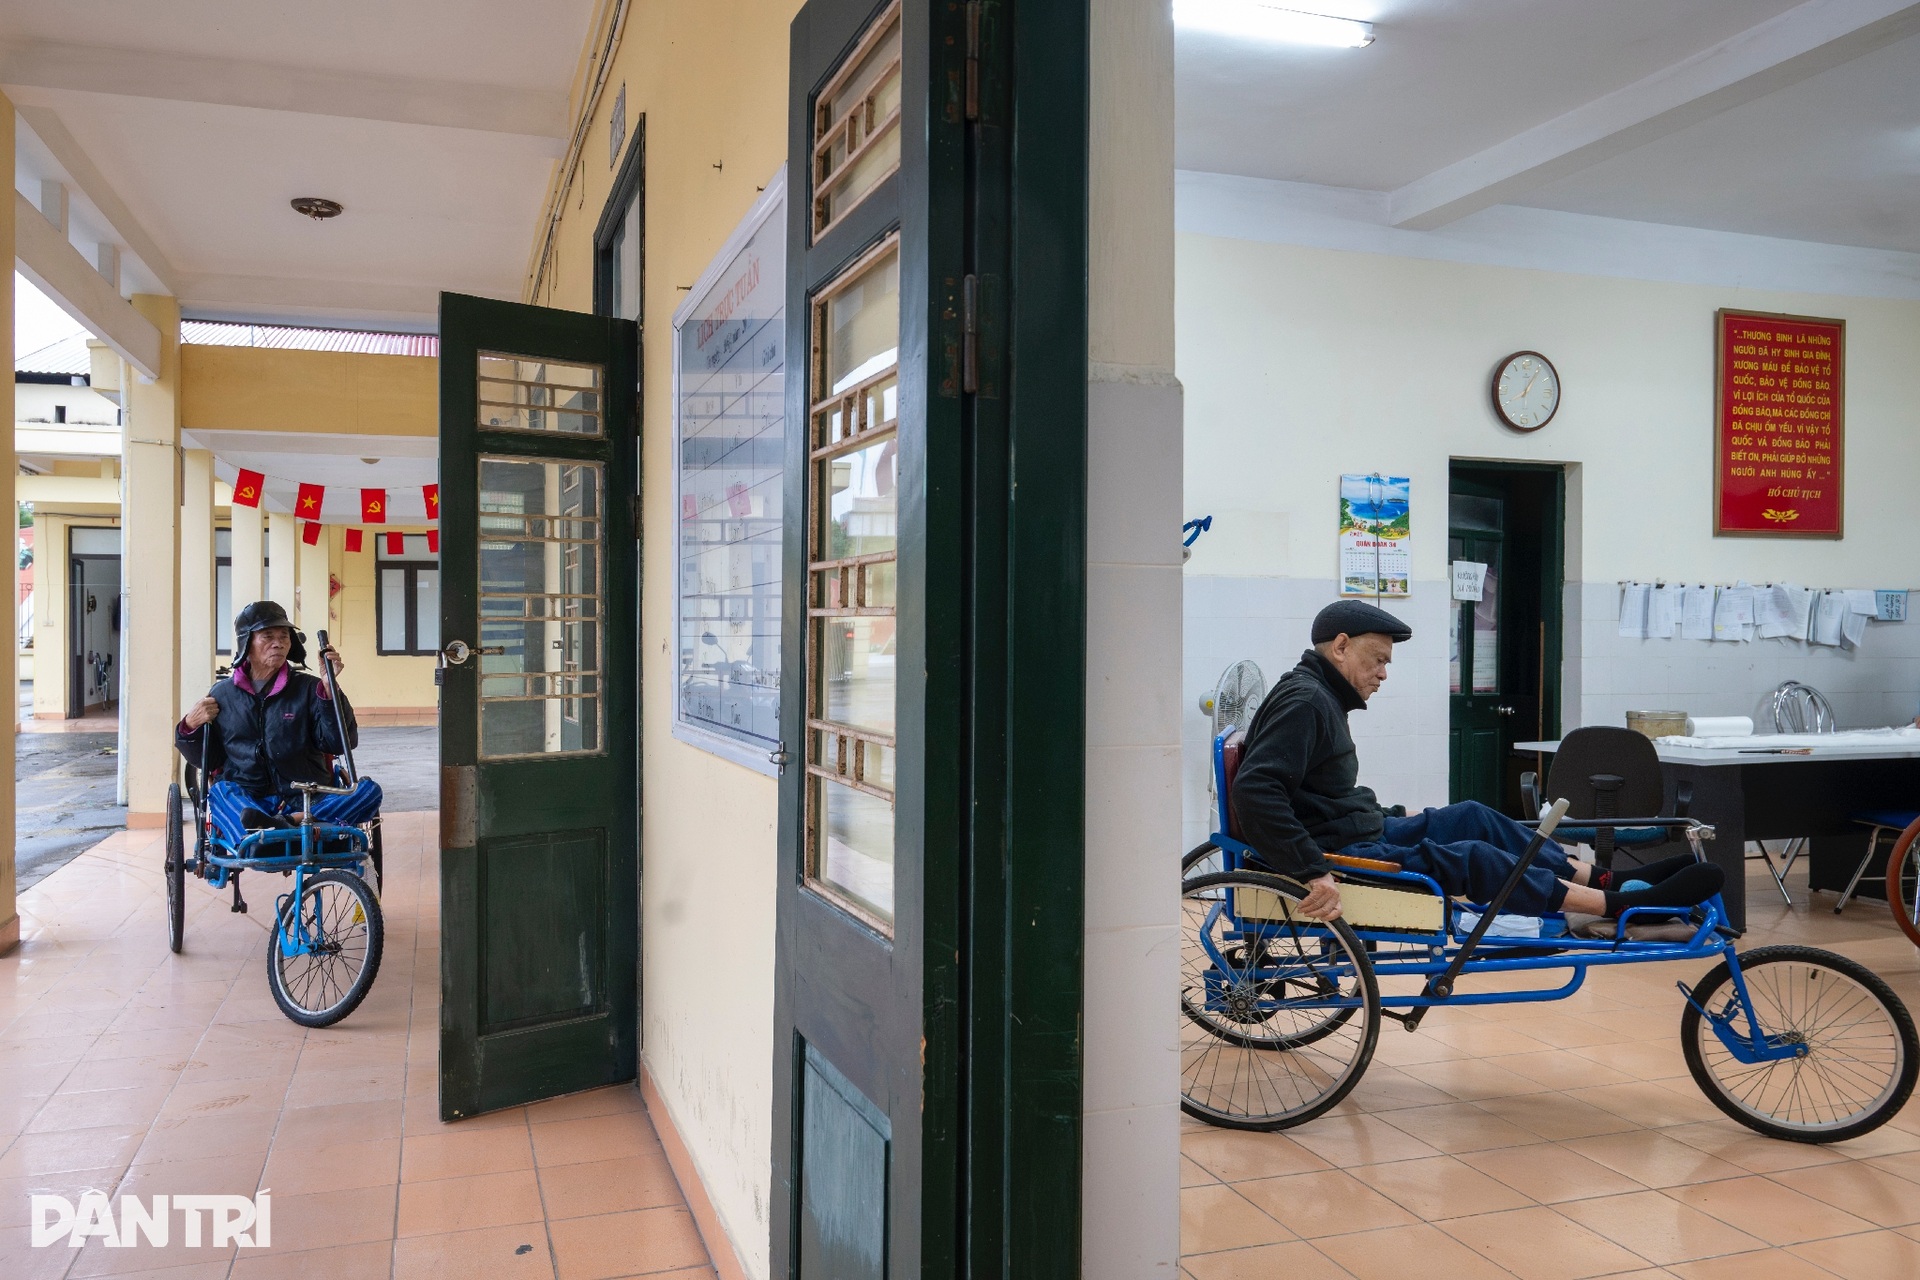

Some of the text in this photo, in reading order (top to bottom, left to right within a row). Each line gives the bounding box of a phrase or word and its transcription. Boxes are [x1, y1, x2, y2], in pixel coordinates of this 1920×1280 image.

[1776, 333, 1792, 342] BINH
[1797, 334, 1806, 343] LÀ
[1808, 334, 1831, 345] NHỮNG
[1733, 345, 1756, 355] NGƯỜI
[1758, 346, 1768, 356] ĐÃ
[1784, 349, 1800, 358] SINH
[1803, 350, 1814, 359] GIA
[1734, 360, 1758, 370] XƯƠNG
[1762, 362, 1778, 371] MÁU
[1811, 364, 1819, 376] VỆ
[1779, 378, 1788, 389] VỆ
[1743, 392, 1754, 402] LỢI
[1756, 392, 1768, 401] ÍCH
[1771, 391, 1784, 402] CỦA
[1796, 392, 1816, 404] QUỐC
[1817, 394, 1830, 405] CỦA
[1784, 408, 1798, 418] CÁC
[1820, 410, 1830, 420] CHÍ
[1732, 420, 1742, 430] ĐÃ
[1745, 422, 1762, 432] CHỊU
[1765, 420, 1776, 431] ỐM
[1732, 434, 1753, 446] QUỐC
[1815, 439, 1830, 449] PHẢI
[1731, 449, 1747, 460] BIẾT
[1762, 451, 1779, 462] PHẢI
[1780, 452, 1796, 463] GIÚP
[1808, 454, 1831, 464] NHỮNG
[1731, 466, 1755, 476] NGƯỜI
[1760, 469, 1776, 477] ANH
